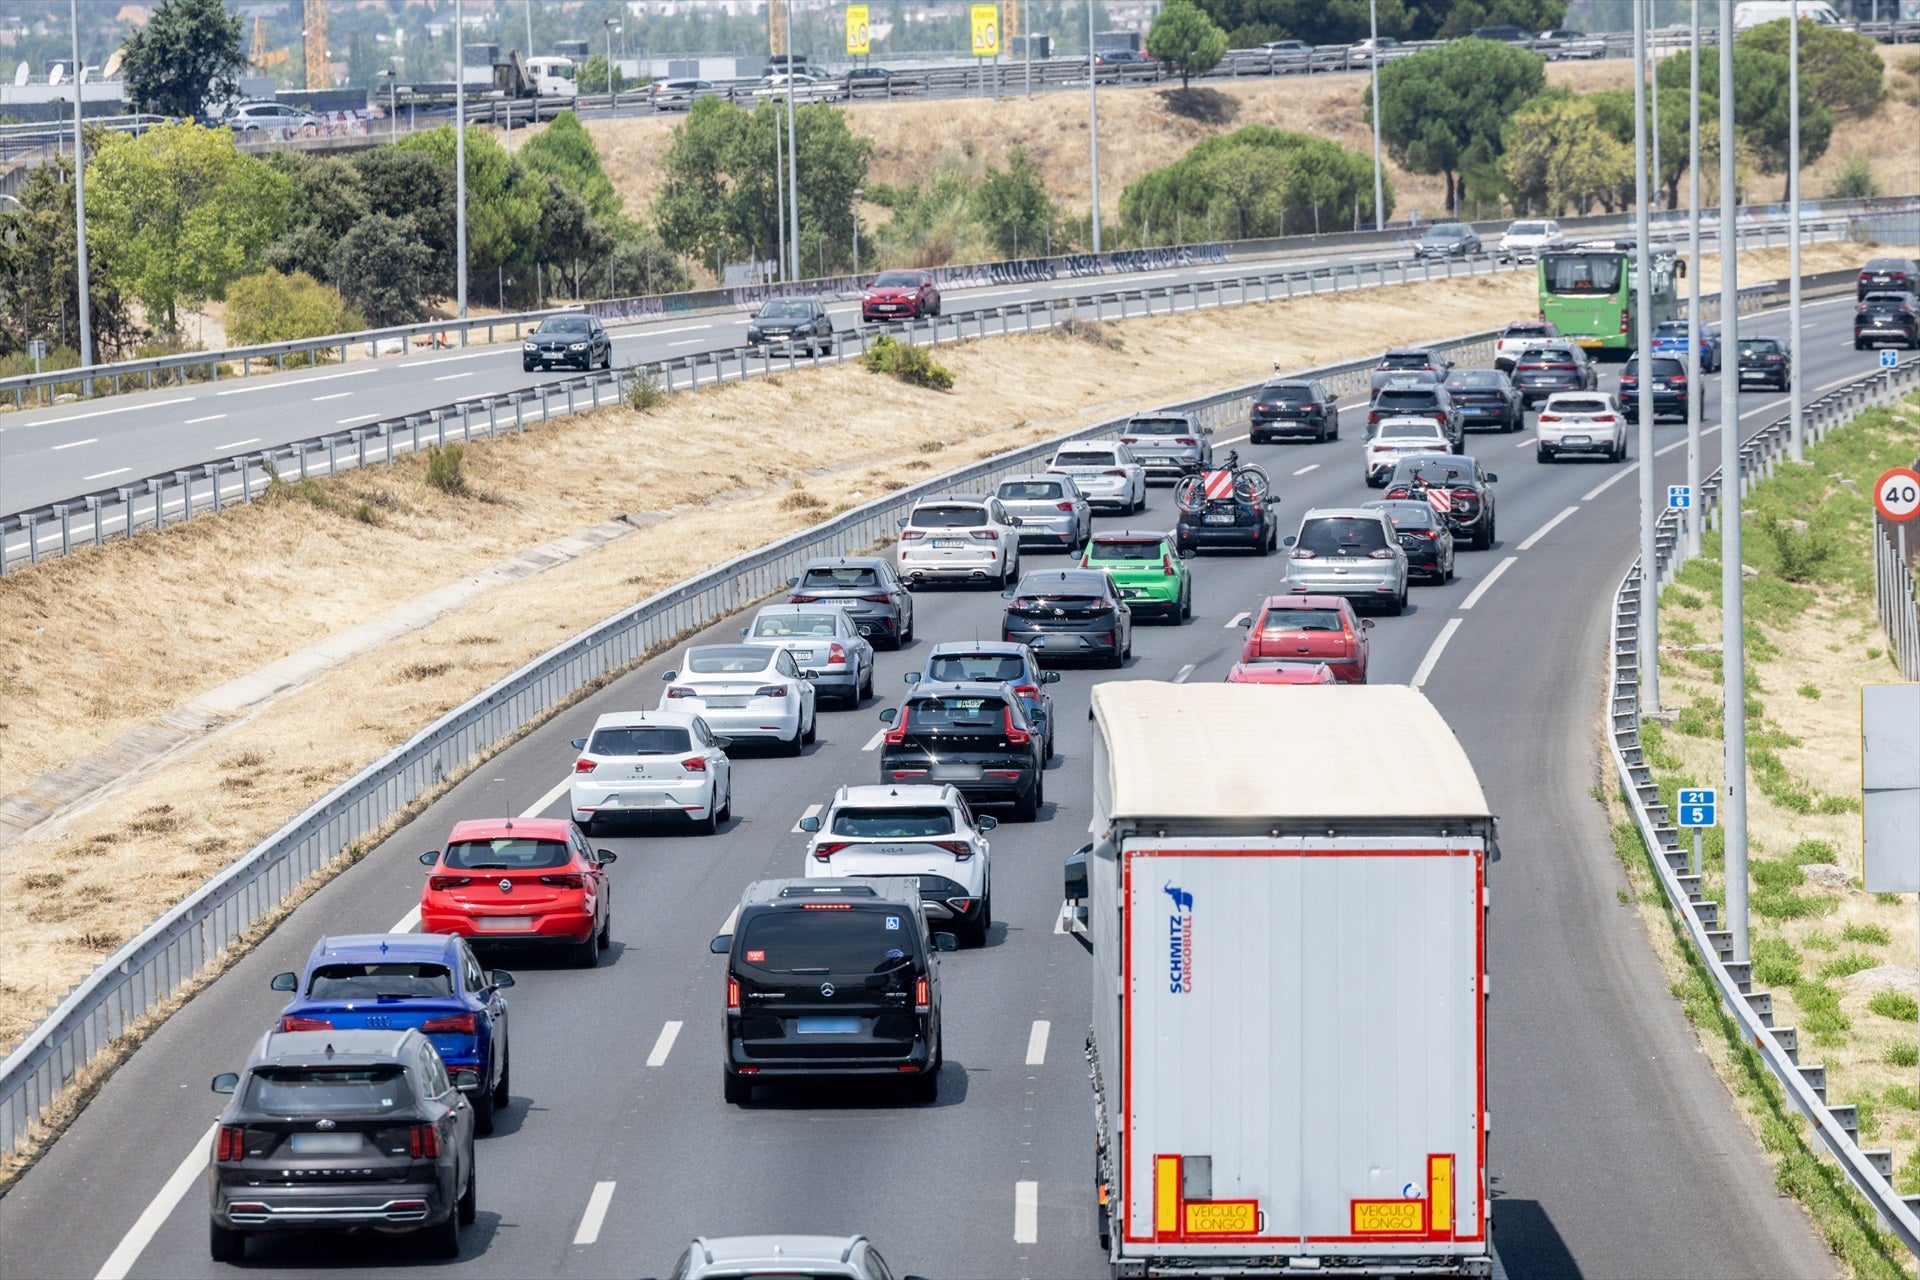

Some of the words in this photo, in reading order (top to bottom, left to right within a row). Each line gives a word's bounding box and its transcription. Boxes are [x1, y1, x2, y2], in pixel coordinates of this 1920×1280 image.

[1674, 487, 1684, 495] 21
[1885, 486, 1916, 503] 40
[1676, 497, 1684, 506] 6
[1689, 792, 1704, 803] 21
[1692, 807, 1704, 823] 5
[1170, 915, 1182, 993] SCHMITZ
[1183, 915, 1192, 993] CARGOBULL
[1192, 1205, 1247, 1217] VEICULO
[1360, 1204, 1415, 1217] VEICULO
[1195, 1218, 1245, 1230] LONGO
[1363, 1217, 1413, 1229] LONGO
